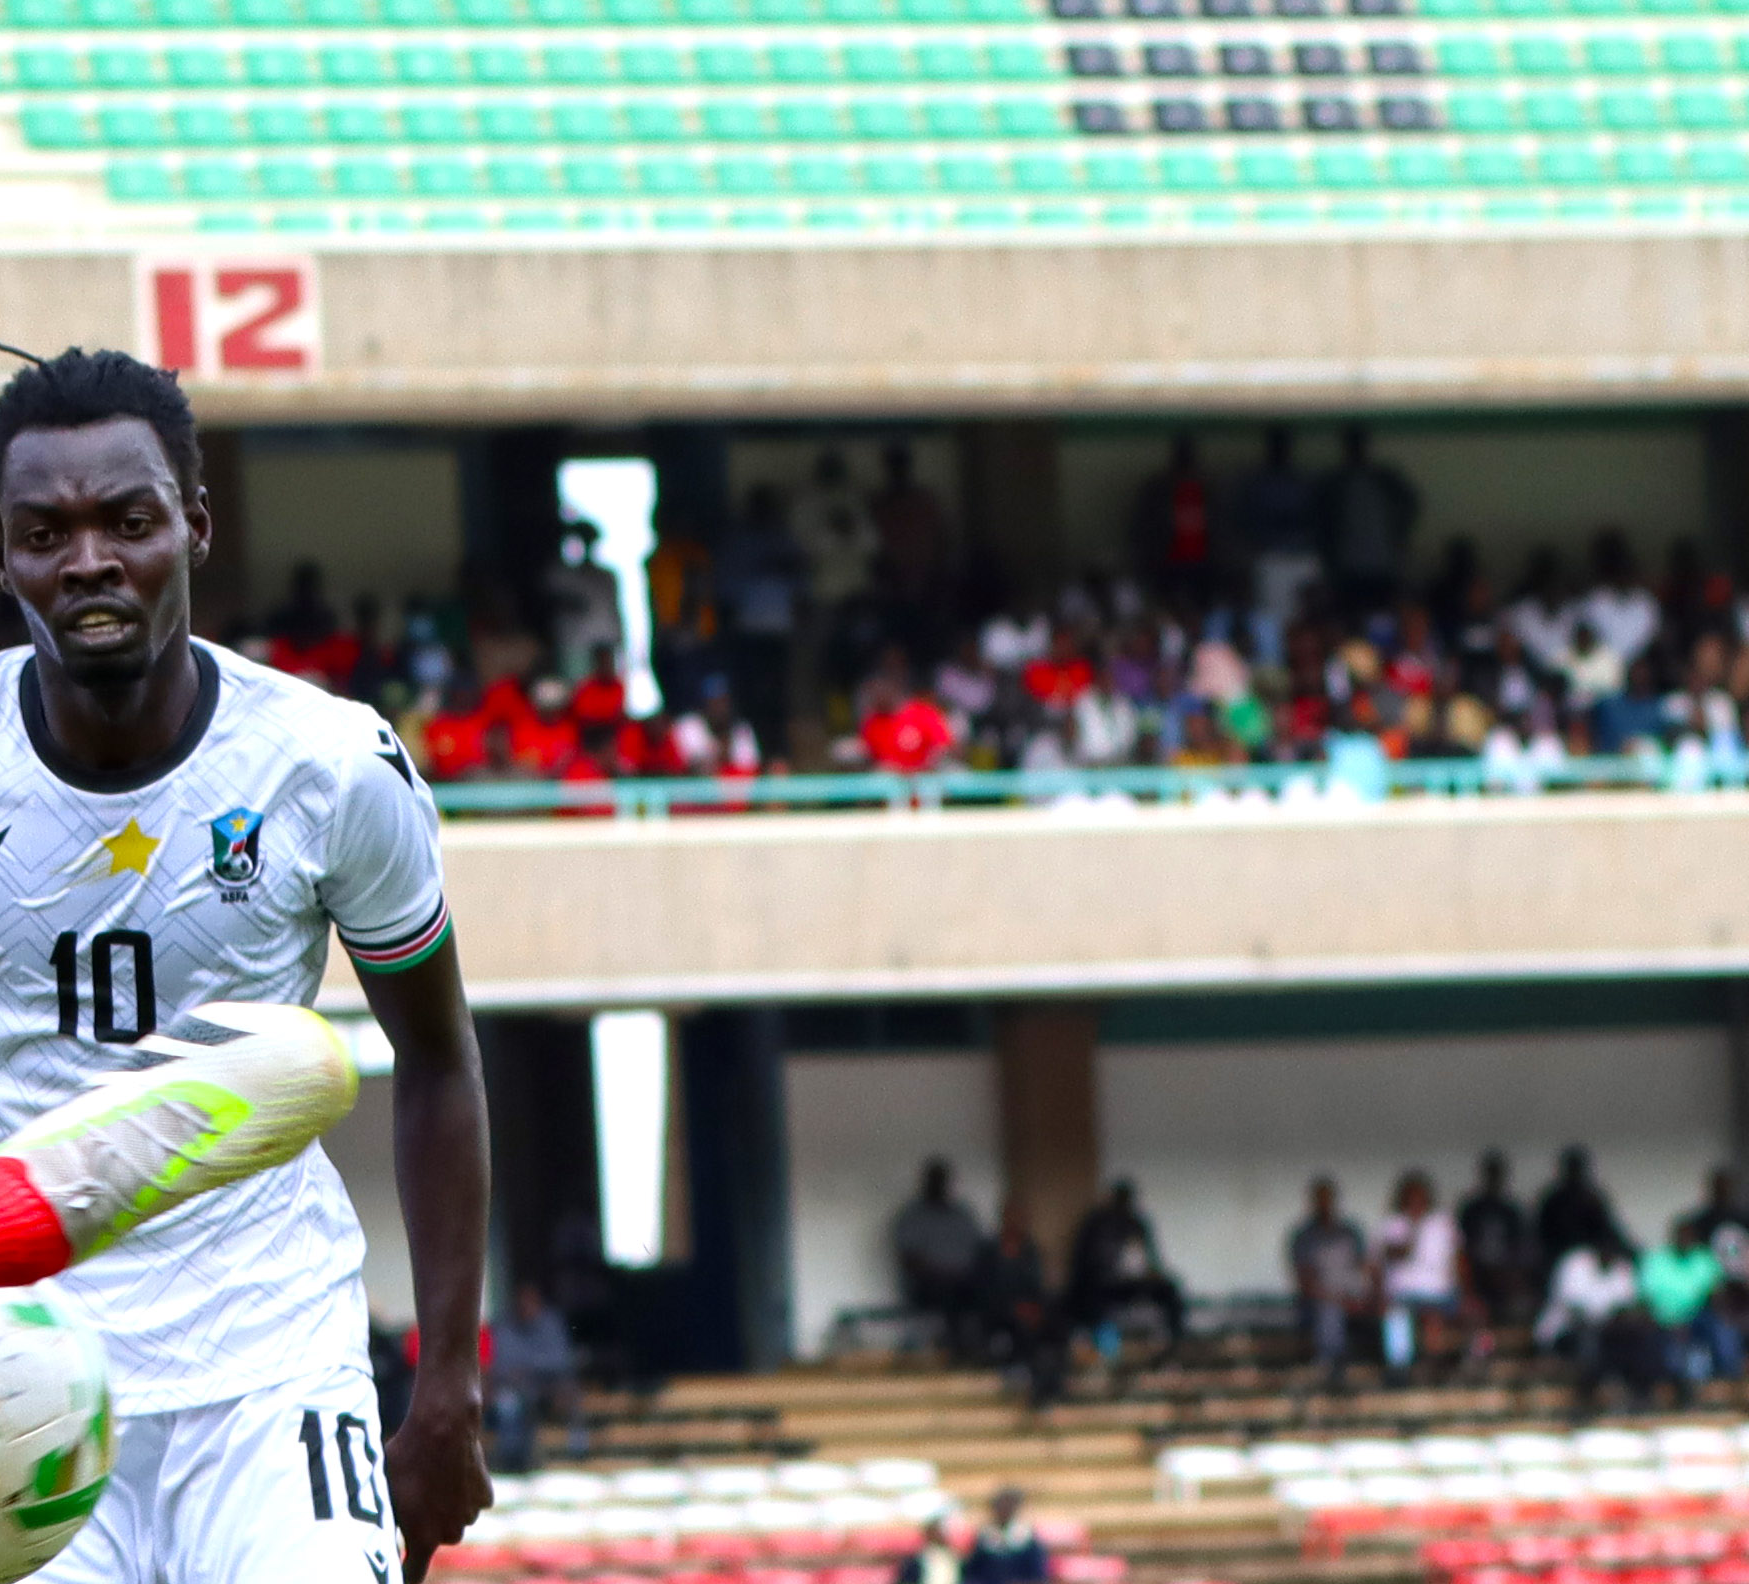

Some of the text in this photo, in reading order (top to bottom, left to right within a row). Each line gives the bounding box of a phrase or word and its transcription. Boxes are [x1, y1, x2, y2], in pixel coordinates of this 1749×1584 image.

[154, 268, 305, 370] 12
[48, 929, 157, 1045] 10
[298, 1408, 384, 1530] 10
